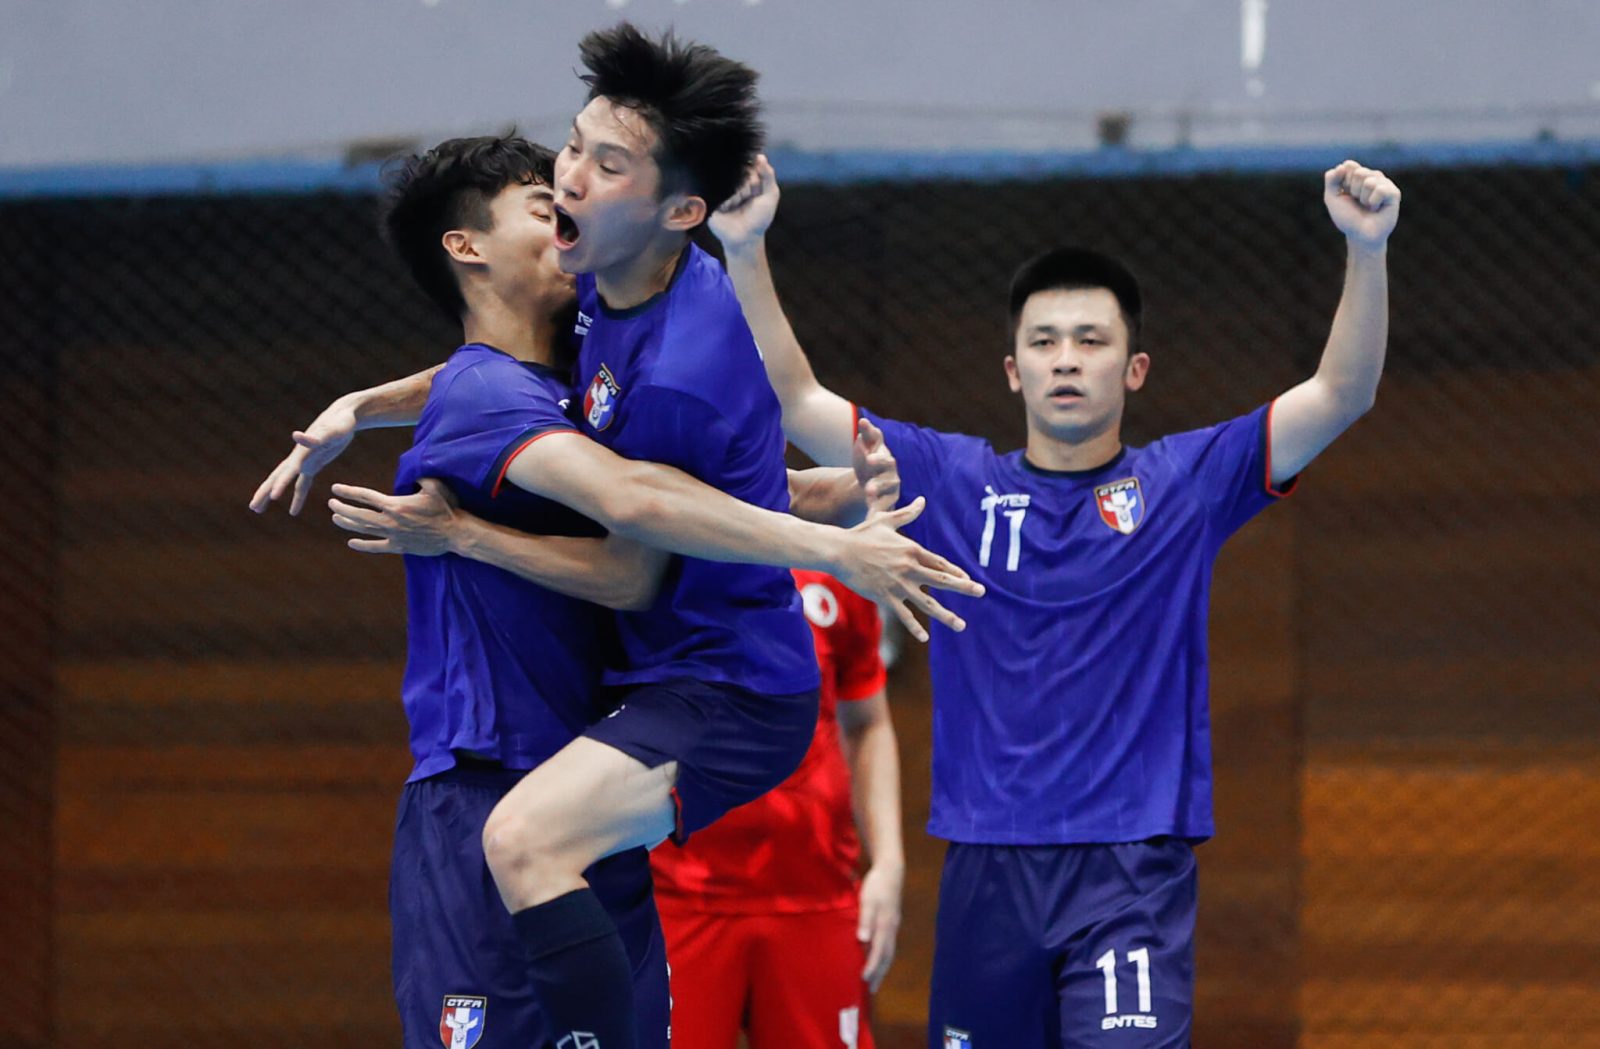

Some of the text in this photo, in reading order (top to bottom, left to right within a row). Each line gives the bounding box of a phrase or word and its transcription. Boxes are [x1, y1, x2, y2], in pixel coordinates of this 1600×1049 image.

[979, 496, 1027, 572] 11
[1096, 947, 1152, 1014] 11
[1101, 1014, 1158, 1030] ENTES
